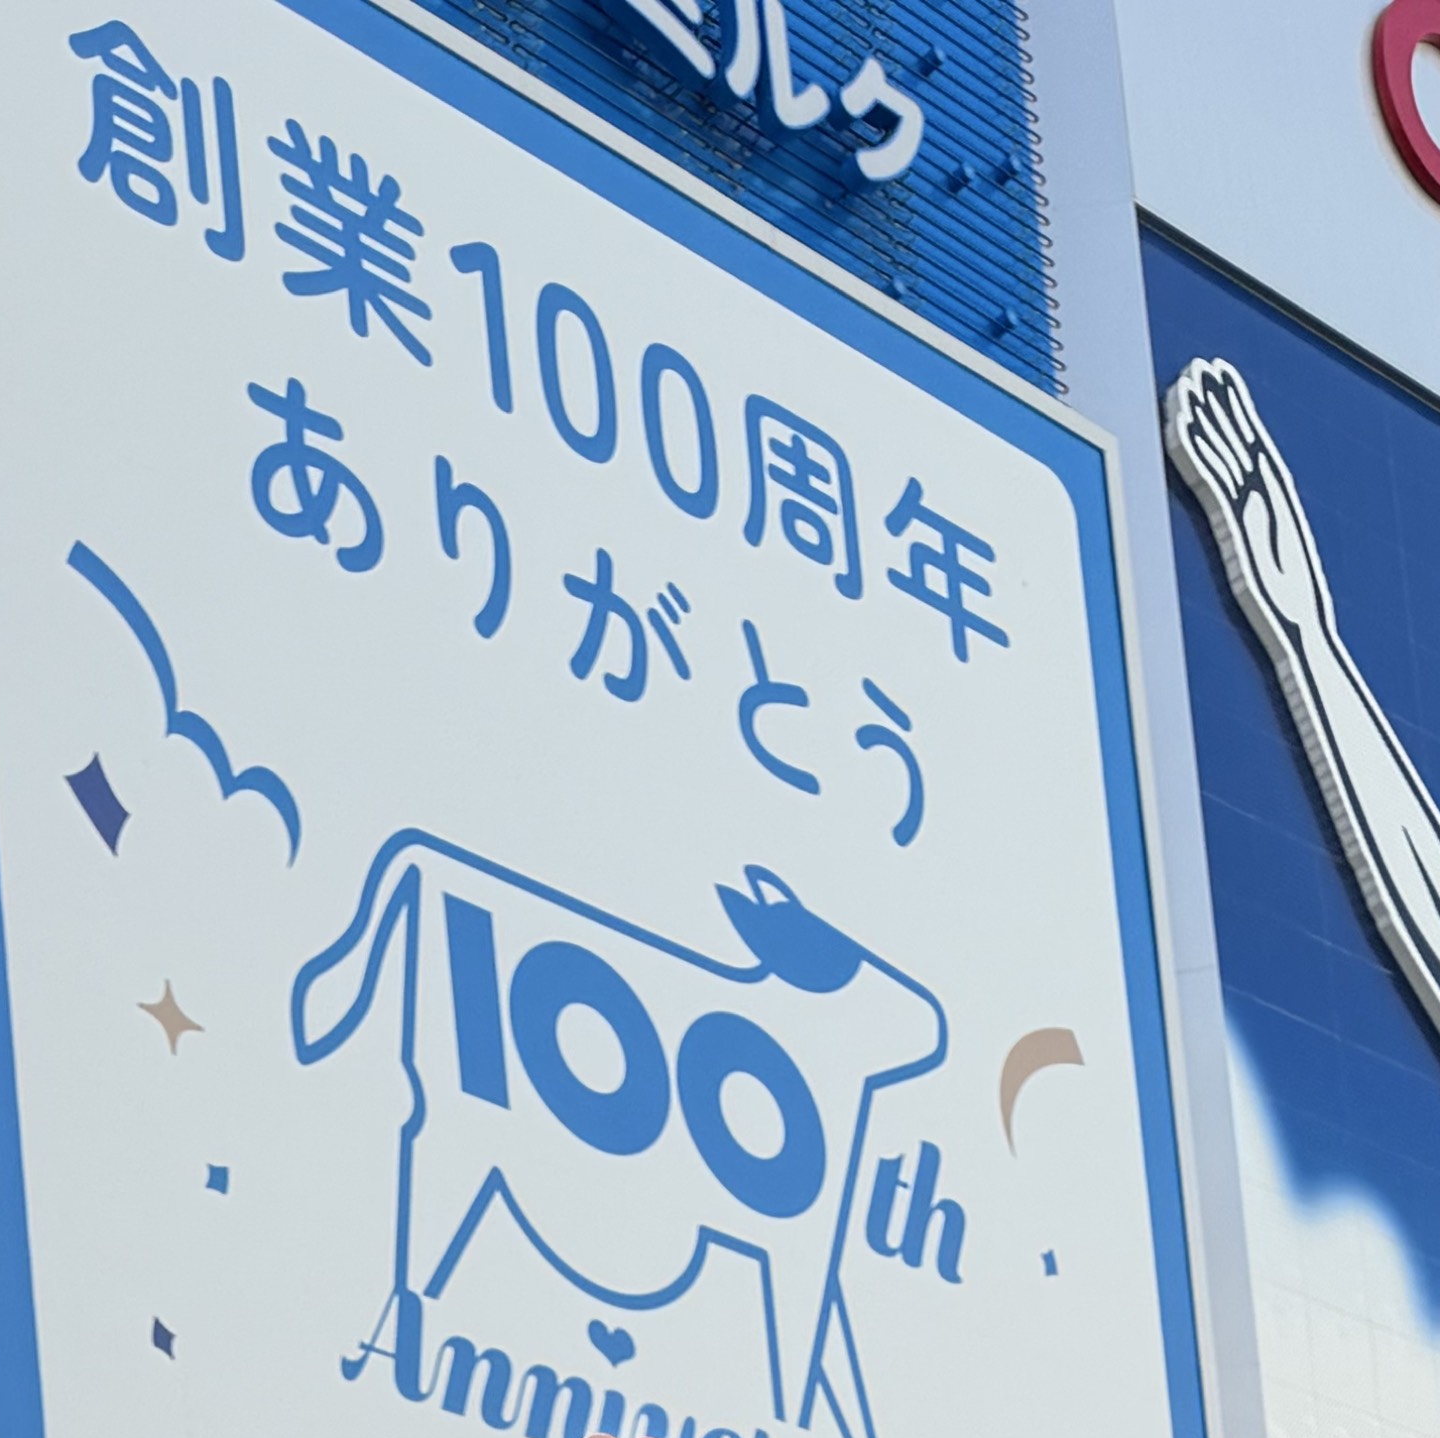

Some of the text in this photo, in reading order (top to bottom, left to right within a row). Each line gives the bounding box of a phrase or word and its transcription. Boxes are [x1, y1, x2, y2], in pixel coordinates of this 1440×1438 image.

[68, 20, 1011, 664] 創業100周年
[247, 377, 926, 848] ありがとう
